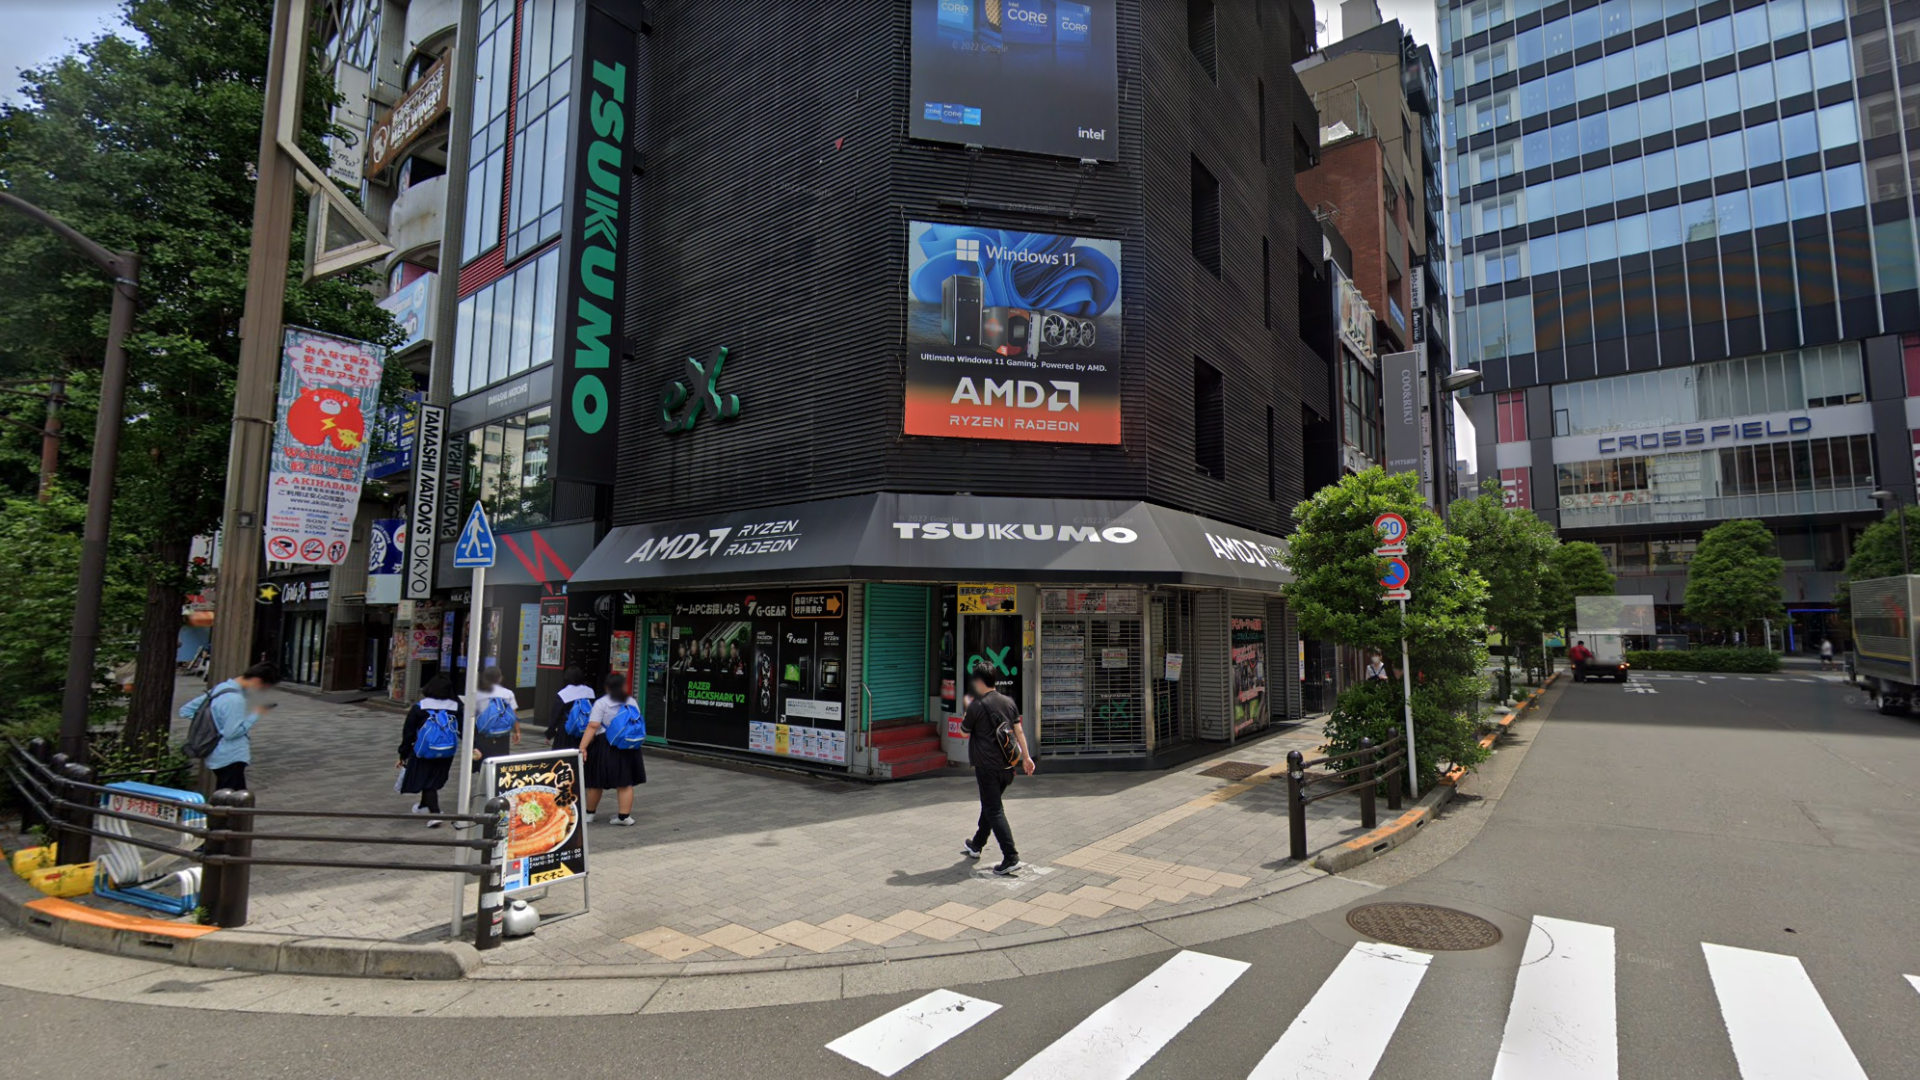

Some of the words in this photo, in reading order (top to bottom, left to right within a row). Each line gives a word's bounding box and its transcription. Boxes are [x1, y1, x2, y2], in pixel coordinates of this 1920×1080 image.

[1078, 127, 1106, 141] intel
[571, 60, 627, 435] TSUKUMO
[985, 245, 1059, 265] Windows
[1062, 253, 1076, 267] 11
[304, 345, 370, 366] みんなで協力
[920, 353, 955, 363] Ultimate
[957, 355, 993, 365] Windows
[1006, 359, 1039, 369] Gaming.
[1041, 361, 1074, 371] Powered
[1075, 363, 1086, 373] by
[1087, 364, 1107, 372] AMD.
[950, 376, 1046, 408] AMD
[1401, 369, 1413, 425] COO&RIKU
[950, 415, 1004, 428] RYZEN
[1014, 419, 1079, 432] RADEON
[421, 410, 440, 472] TAMASHII
[283, 446, 361, 468] Welcome!
[291, 476, 358, 493] AKIHABARA
[290, 498, 344, 510] www.akiba.or.jp
[416, 473, 434, 535] NATIONS
[737, 519, 799, 538] RYZEN
[892, 522, 1138, 544] TSUKUMO
[625, 533, 702, 564] AMD
[723, 538, 799, 557] RADEON
[1204, 532, 1256, 564] AMD
[412, 538, 430, 593] TOKYO
[675, 603, 741, 616] ゲームPCお探しなら
[756, 605, 787, 617] G-GEAR
[688, 681, 711, 691] RAZER
[688, 689, 734, 703] BLACKSHARK
[735, 694, 745, 704] V2
[534, 870, 564, 883] すぐそこ
